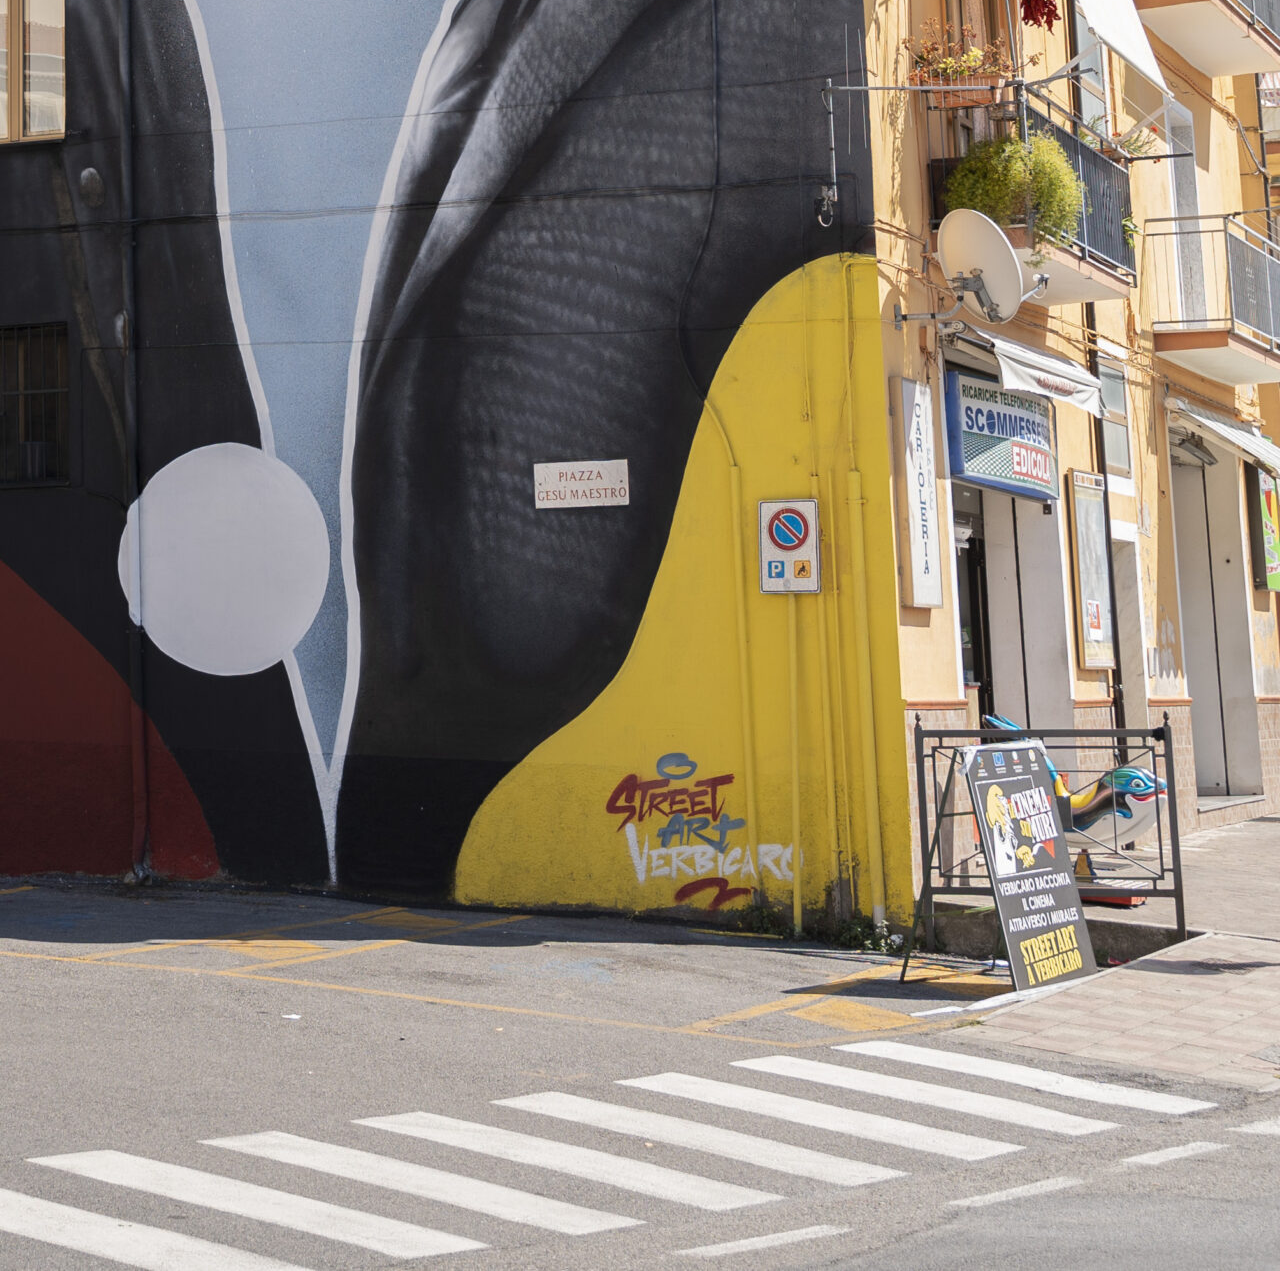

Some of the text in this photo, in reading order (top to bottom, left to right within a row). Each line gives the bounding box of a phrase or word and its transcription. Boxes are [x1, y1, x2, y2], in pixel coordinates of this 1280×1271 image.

[961, 384, 998, 404] RICARICHE
[558, 470, 603, 482] PIAZZA
[1013, 446, 1051, 481] EDICOLA
[570, 486, 627, 500] MAESTRO
[606, 773, 735, 833] STREET
[1010, 786, 1052, 820] CINEMA
[998, 872, 1071, 897] VERBICARO RACCONTA
[1028, 893, 1056, 910] CINEMA
[1008, 913, 1047, 933] ATTRAVERSO
[1051, 907, 1079, 924] MURALES
[1019, 924, 1079, 965] STREET ART
[1026, 948, 1083, 986] A VERBICARO
